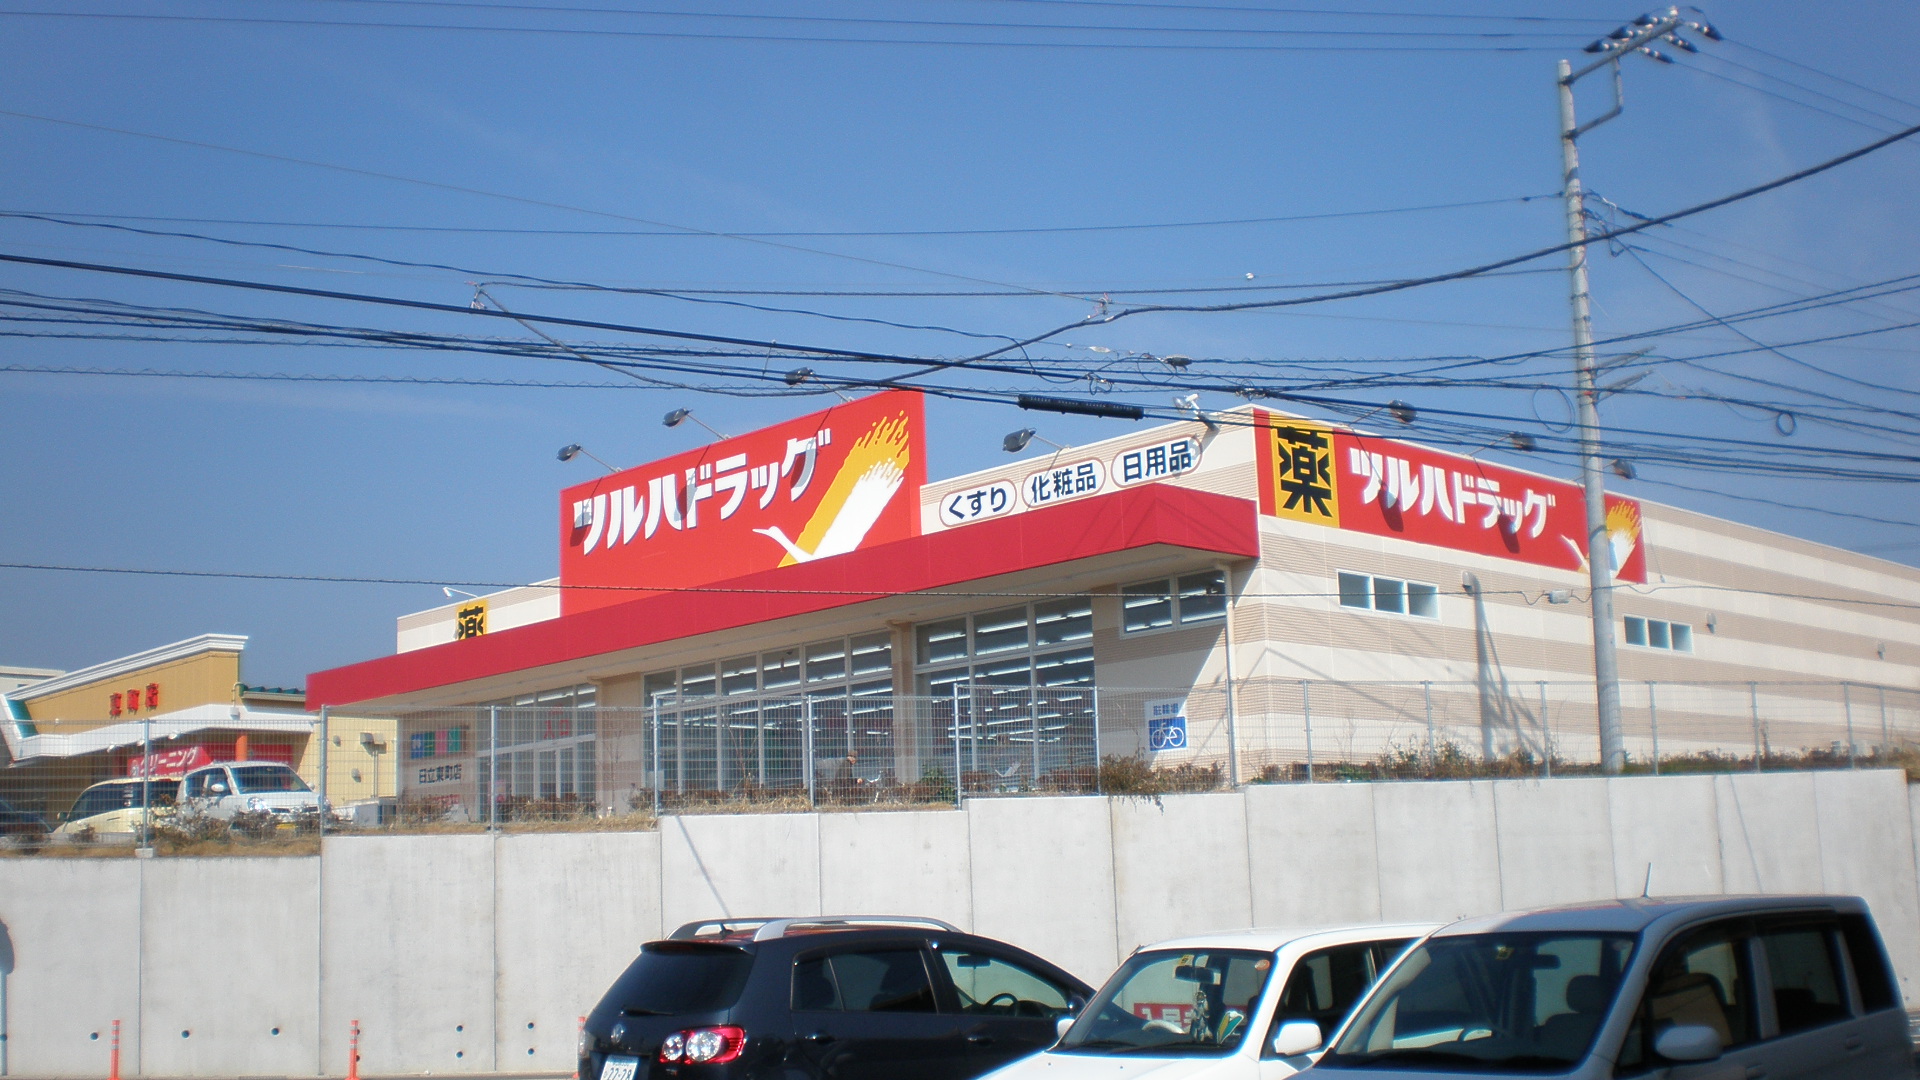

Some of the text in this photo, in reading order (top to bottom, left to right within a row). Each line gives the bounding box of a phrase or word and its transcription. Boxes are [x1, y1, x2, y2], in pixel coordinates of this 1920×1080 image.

[573, 427, 832, 555] ツルハドラッグ
[1031, 463, 1097, 503] 化粧品
[1122, 441, 1192, 483] 日用品
[1276, 426, 1333, 518] 薬
[1350, 447, 1556, 538] ツルハドラッグ
[948, 488, 1007, 519] くすり
